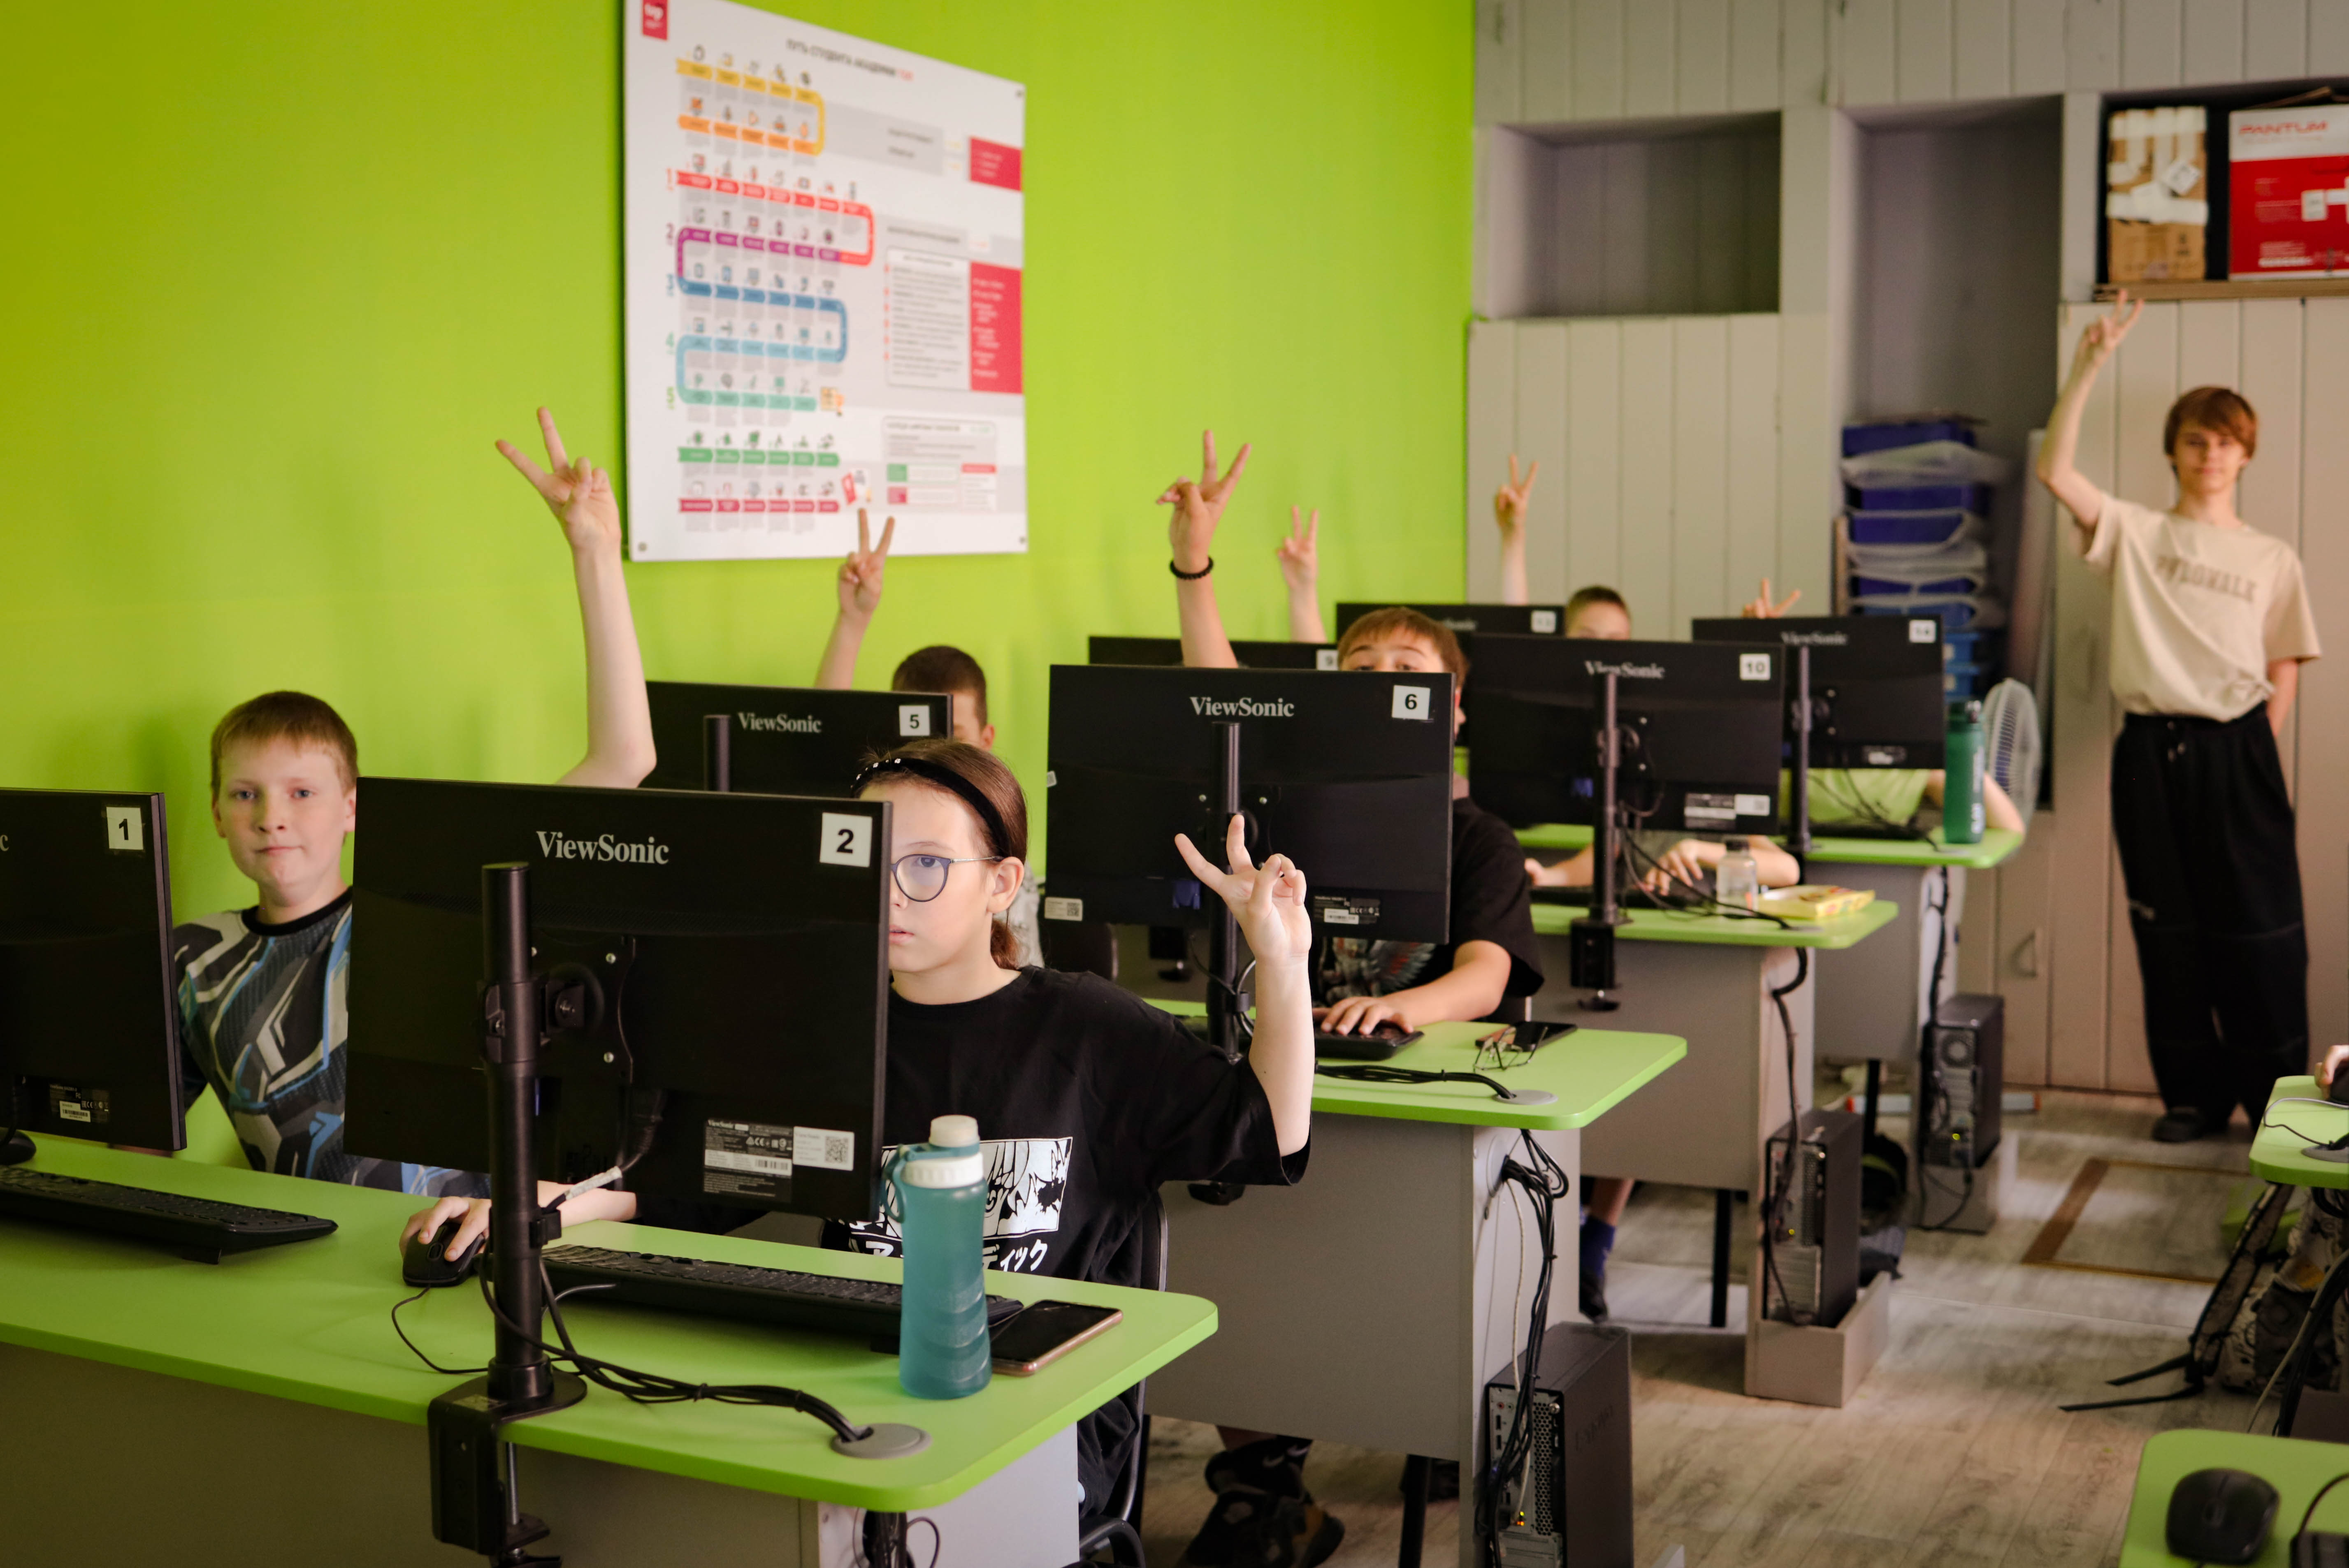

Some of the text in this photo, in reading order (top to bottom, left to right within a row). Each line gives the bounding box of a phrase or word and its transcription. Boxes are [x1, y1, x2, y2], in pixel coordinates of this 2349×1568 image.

[2239, 121, 2329, 137] PANTUM
[1585, 661, 1665, 679] ViewSonic
[1746, 661, 1766, 674] 10
[1190, 696, 1294, 717] ViewSonic
[1404, 694, 1418, 710] 6
[738, 712, 822, 733] ViewSonic
[909, 714, 920, 729] 5
[118, 818, 129, 840] 1
[536, 831, 669, 865] ViewSonic
[836, 828, 854, 854] 2
[708, 1119, 734, 1129] ViewSonic
